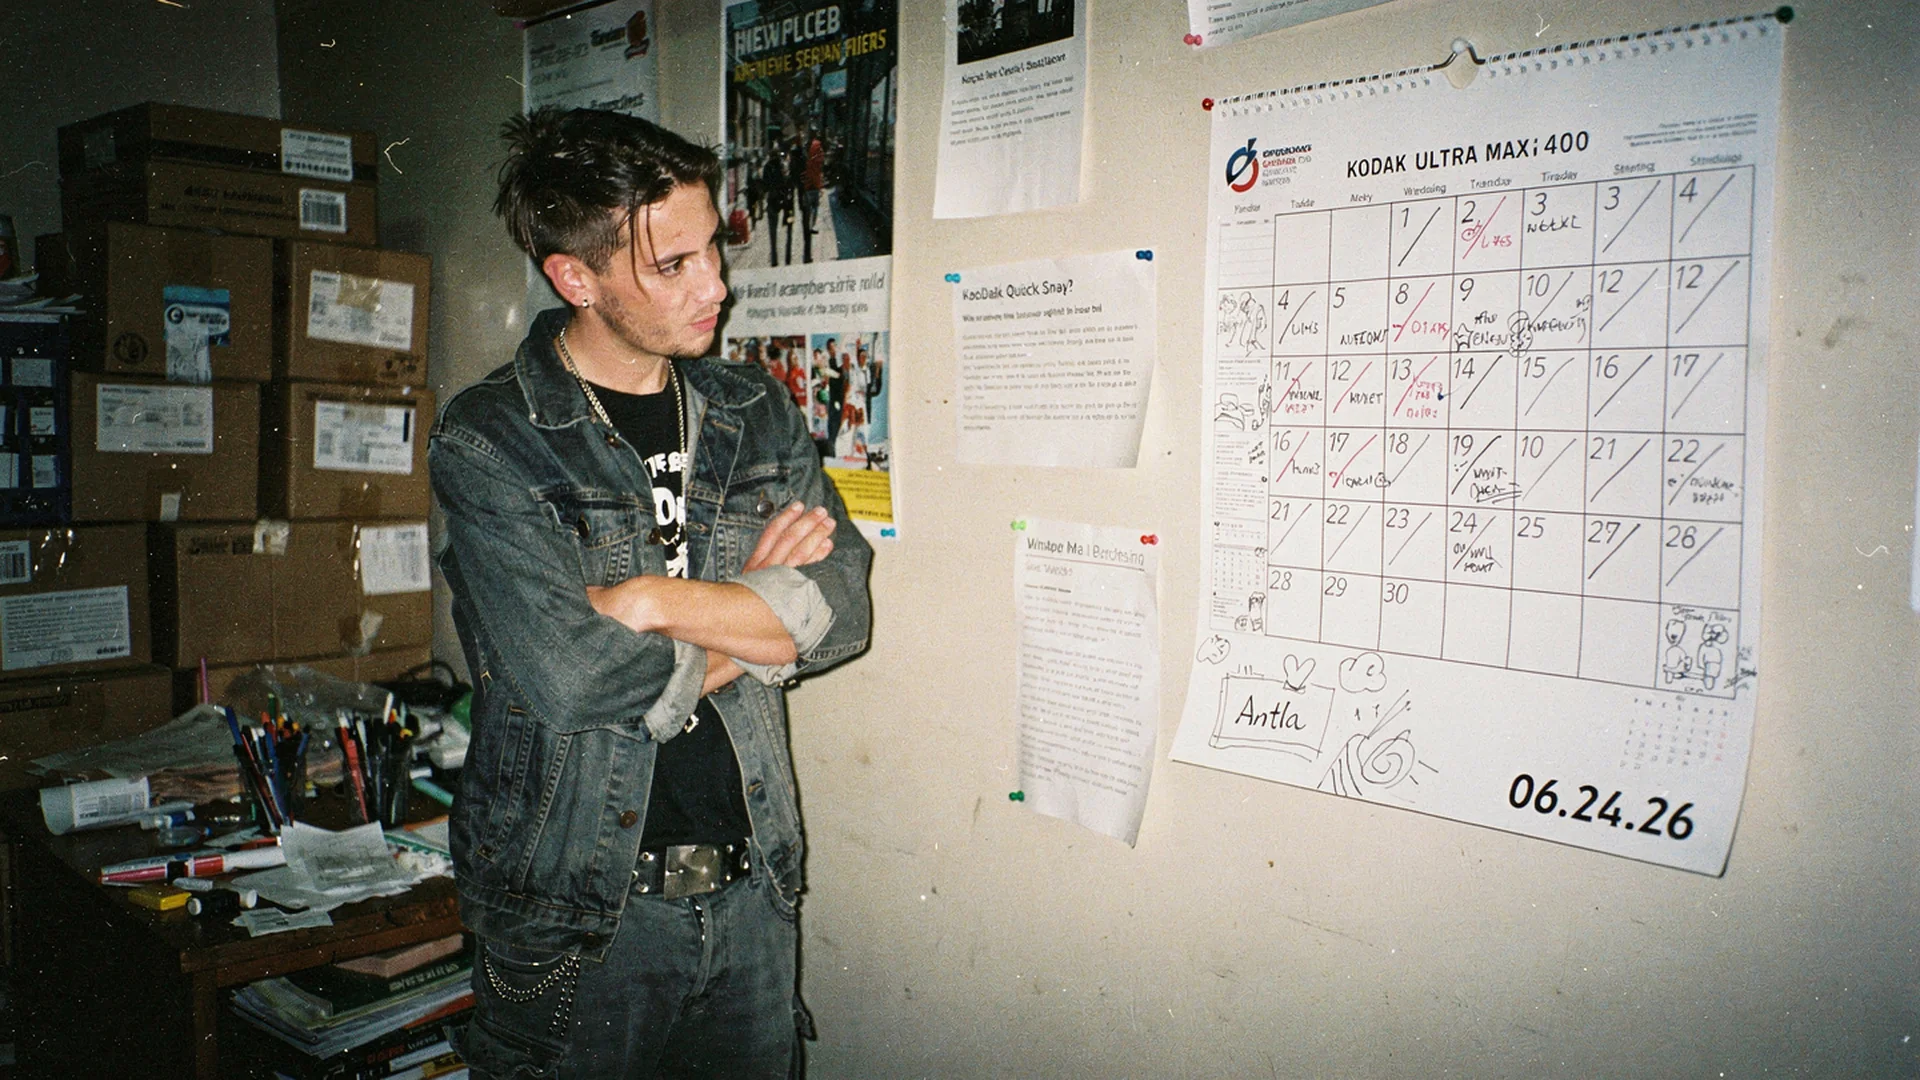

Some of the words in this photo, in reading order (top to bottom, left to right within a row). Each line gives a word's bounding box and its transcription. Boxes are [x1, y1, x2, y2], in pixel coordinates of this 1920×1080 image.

[1347, 154, 1406, 178] KODAK
[1415, 146, 1478, 170] ULTRA
[1543, 130, 1590, 153] 400
[1604, 186, 1621, 210] 3
[1679, 177, 1699, 203] 4
[1461, 201, 1477, 224] 2
[1530, 192, 1548, 216] 3
[1527, 273, 1550, 298] 10
[1599, 269, 1624, 294] 12
[1676, 264, 1704, 290] 12
[1278, 289, 1290, 310] 4
[1333, 287, 1346, 309] 5
[1395, 282, 1409, 304] 8
[1460, 278, 1475, 301] 9
[1274, 361, 1291, 381] 11
[1331, 359, 1352, 382] 12
[1392, 358, 1413, 381] 13
[1454, 357, 1475, 379] 14
[1524, 356, 1547, 379] 15
[1595, 355, 1619, 379] 16
[1673, 353, 1699, 377] 17
[1272, 430, 1291, 452] 16
[1330, 432, 1350, 453] 17
[1390, 432, 1409, 454] 18
[1453, 434, 1474, 457] 19
[1521, 435, 1544, 459] 10
[1590, 436, 1617, 461] 21
[1668, 439, 1701, 463] 22
[1271, 500, 1290, 521] 21
[1326, 504, 1350, 525] 22
[1386, 507, 1410, 529] 23
[1449, 511, 1478, 534] 24
[1517, 515, 1545, 539] 25
[1588, 519, 1621, 544] 27
[1269, 570, 1293, 592] 28
[1324, 575, 1348, 598] 29
[1383, 582, 1409, 605] 30
[1509, 773, 1695, 841] 06.24.26
